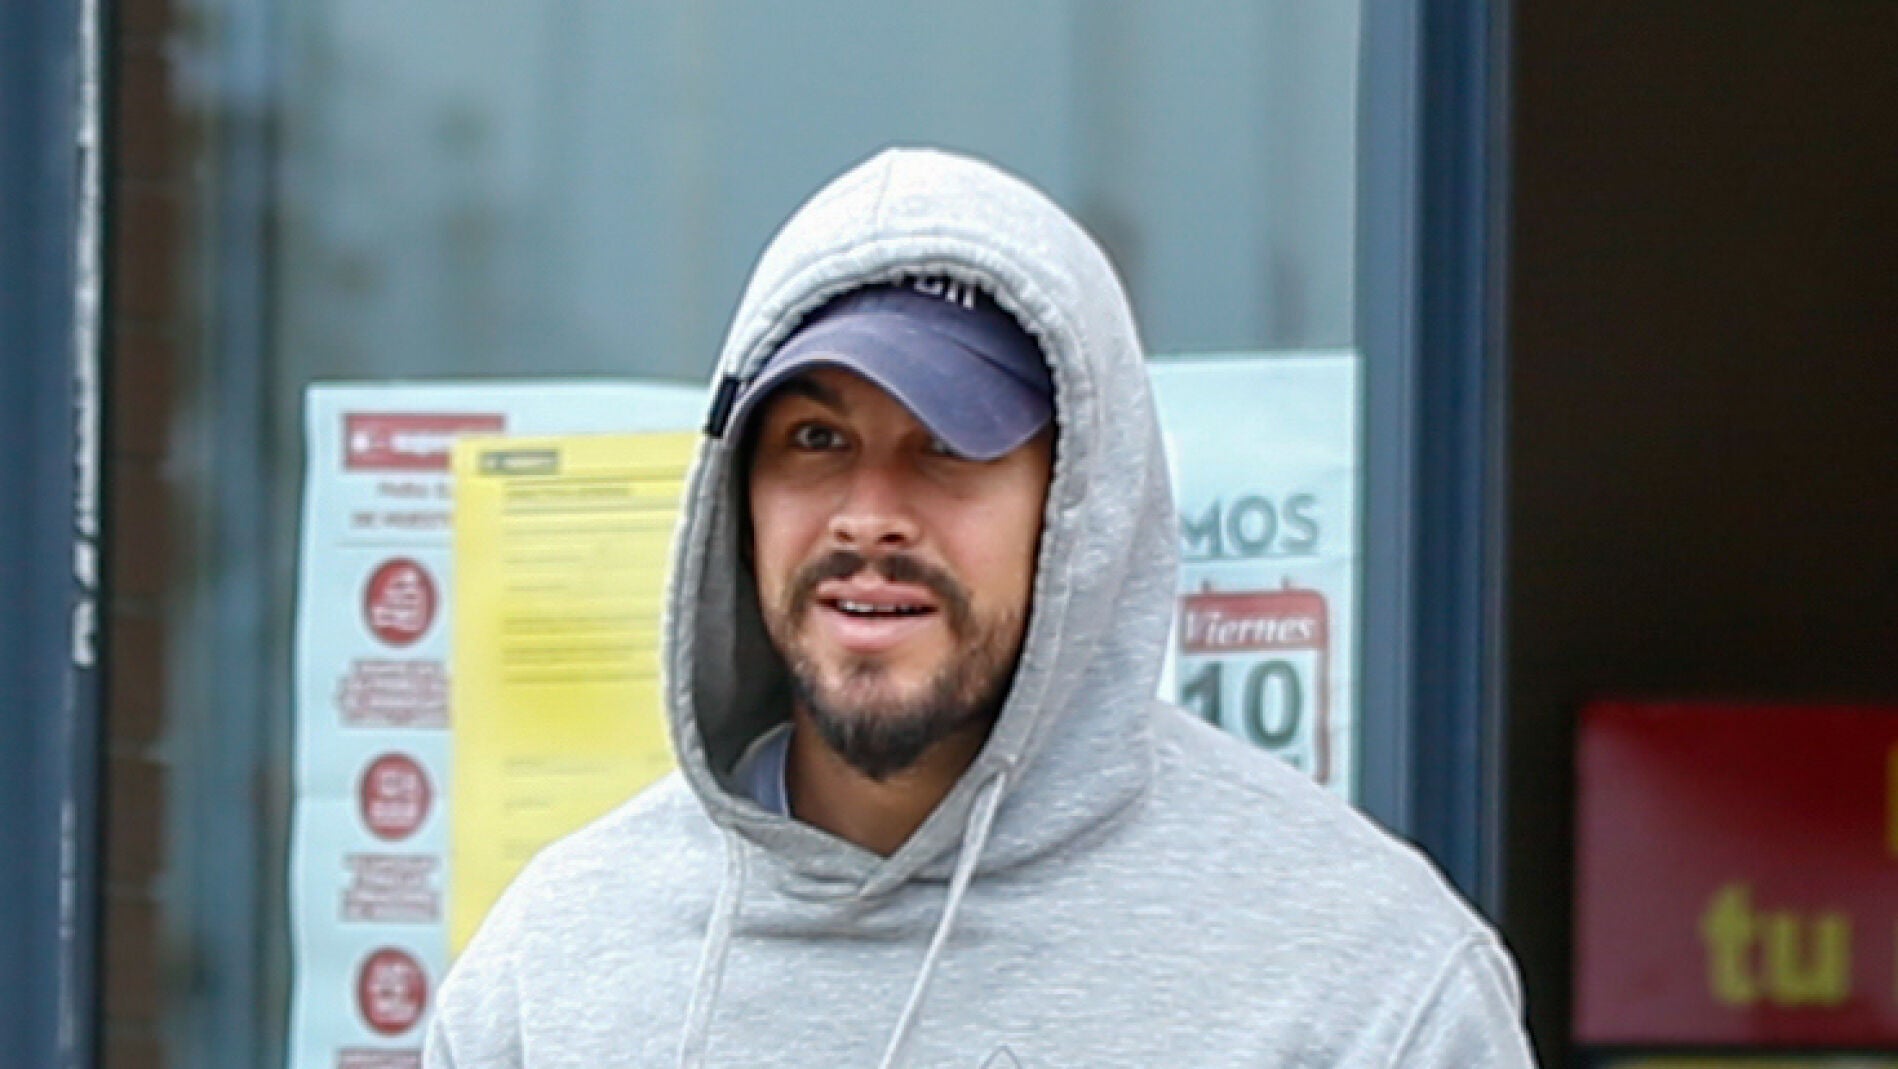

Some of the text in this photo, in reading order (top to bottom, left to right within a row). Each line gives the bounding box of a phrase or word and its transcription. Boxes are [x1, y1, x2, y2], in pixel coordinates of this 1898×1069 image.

[1180, 494, 1319, 556] MOS
[1183, 610, 1314, 646] Viernes
[1181, 660, 1302, 750] 10
[1702, 884, 1850, 1005] tu
